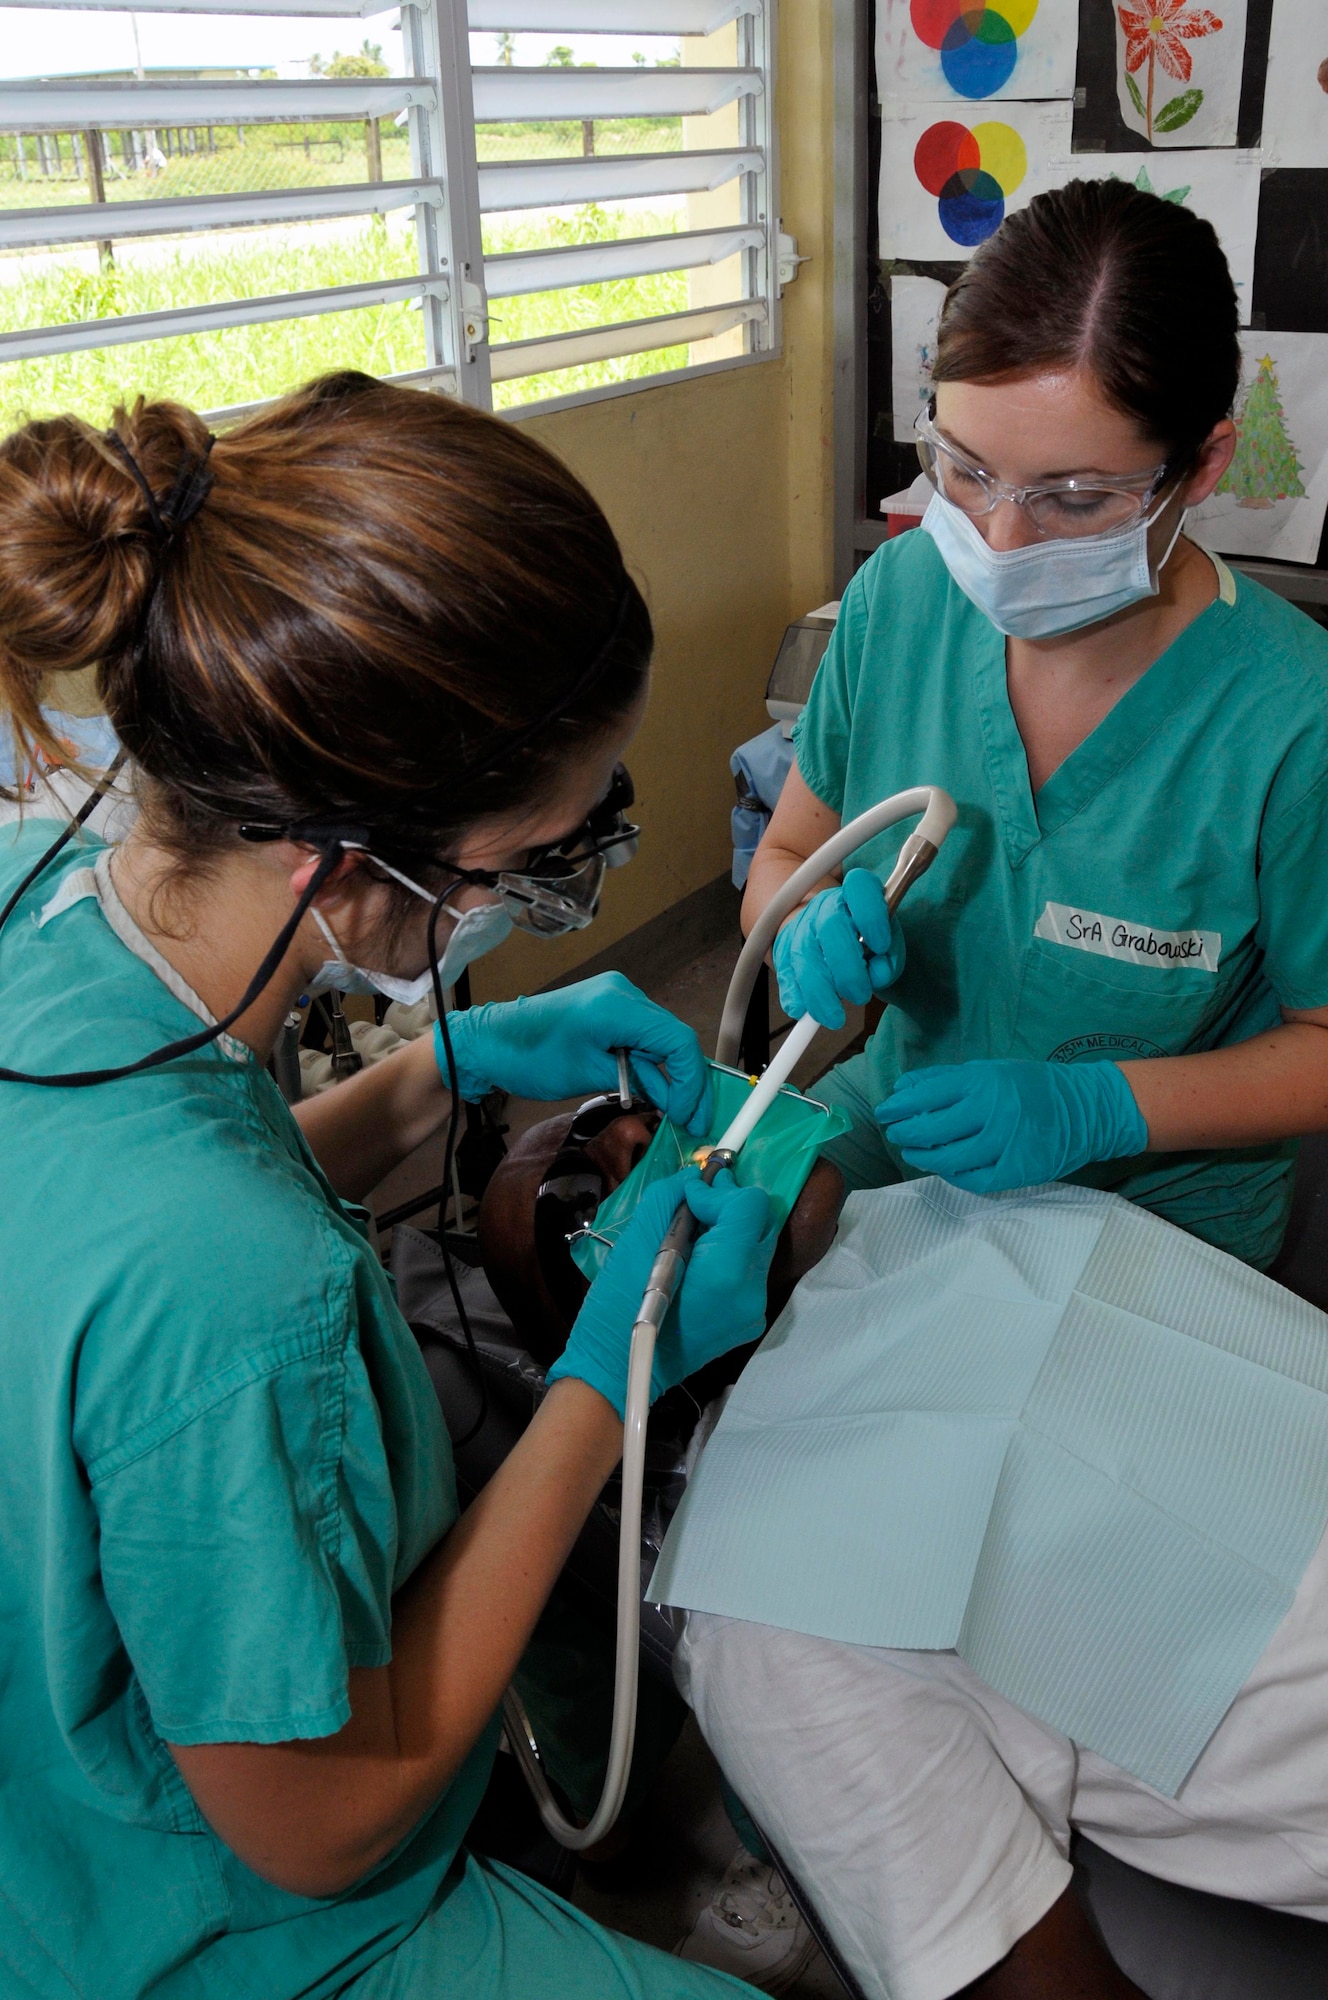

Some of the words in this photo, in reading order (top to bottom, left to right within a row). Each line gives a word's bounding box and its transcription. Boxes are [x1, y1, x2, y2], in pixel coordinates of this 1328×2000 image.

[1066, 914, 1102, 941] SrA
[1112, 925, 1203, 958] Grabowski
[1054, 1041, 1084, 1063] 375TH
[1086, 1036, 1145, 1053] MEDICAL
